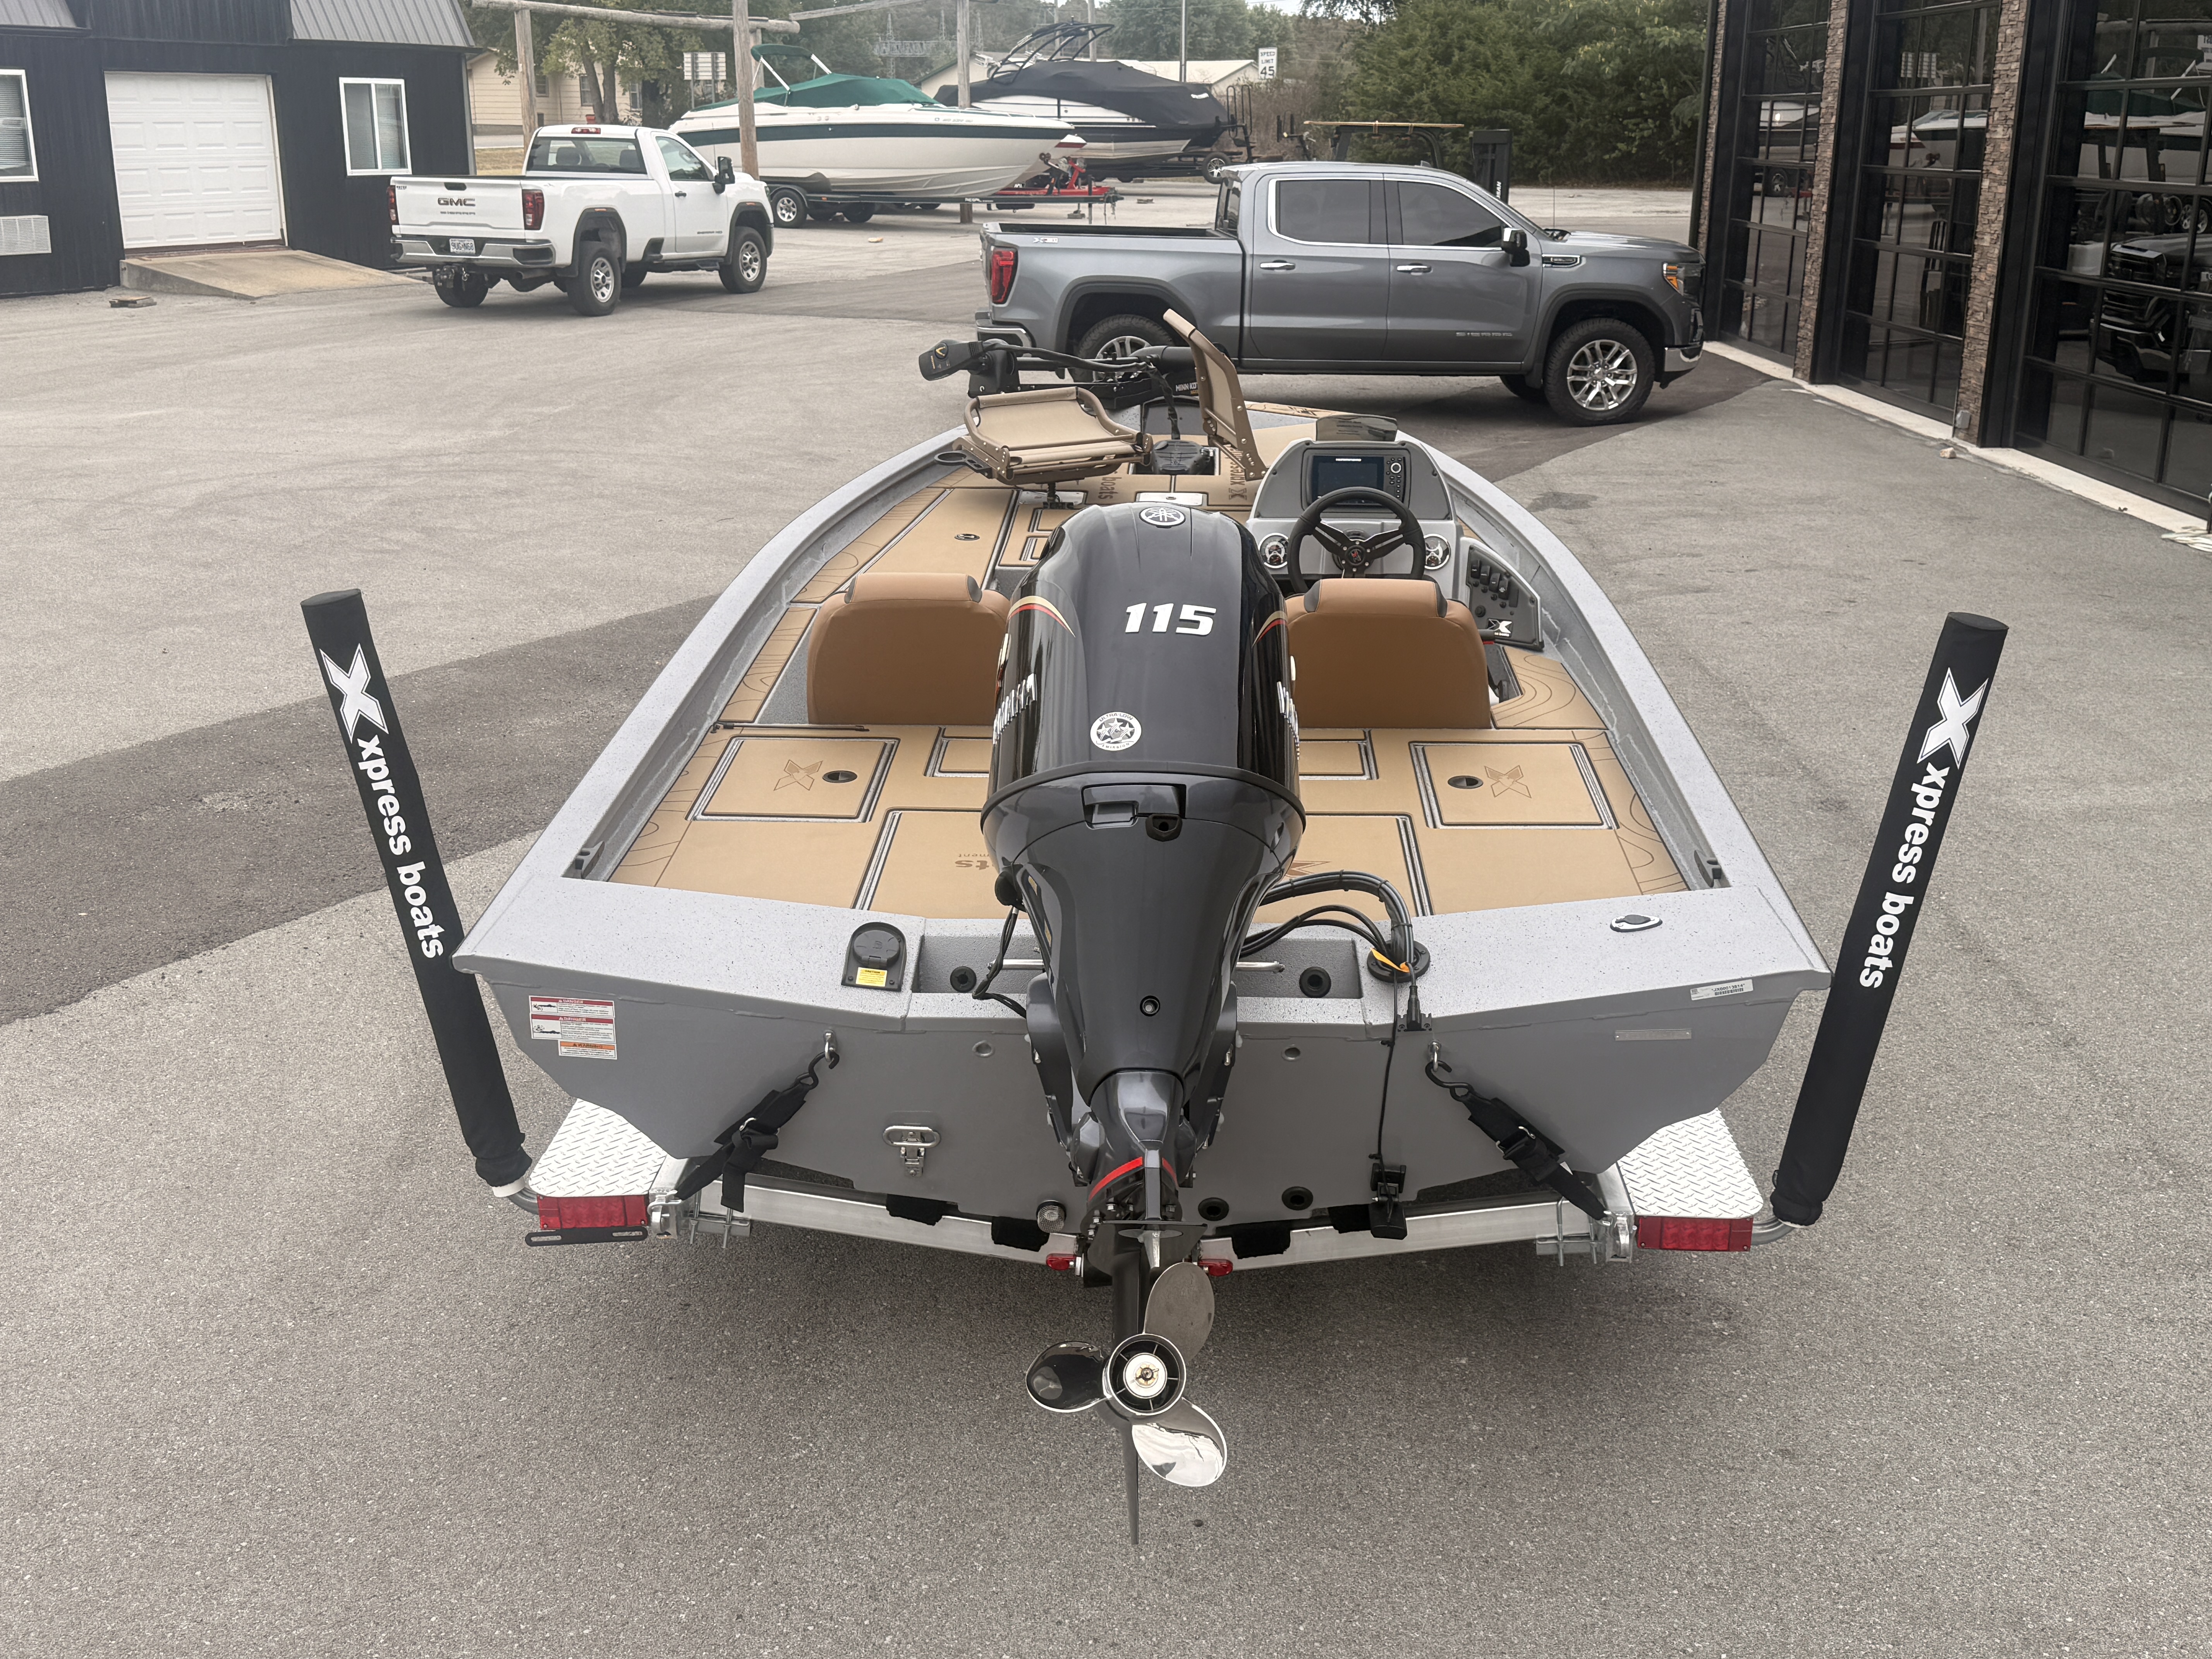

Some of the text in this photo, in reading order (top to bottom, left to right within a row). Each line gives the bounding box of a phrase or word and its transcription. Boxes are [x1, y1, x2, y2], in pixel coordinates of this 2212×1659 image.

[1260, 66, 1275, 76] 45
[438, 198, 476, 206] GMC
[1098, 477, 1122, 499] boats
[1125, 603, 1216, 635] 115
[1892, 762, 1950, 884] xpress
[357, 734, 412, 855] xpress
[397, 861, 445, 958] boats
[1859, 891, 1914, 988] boats
